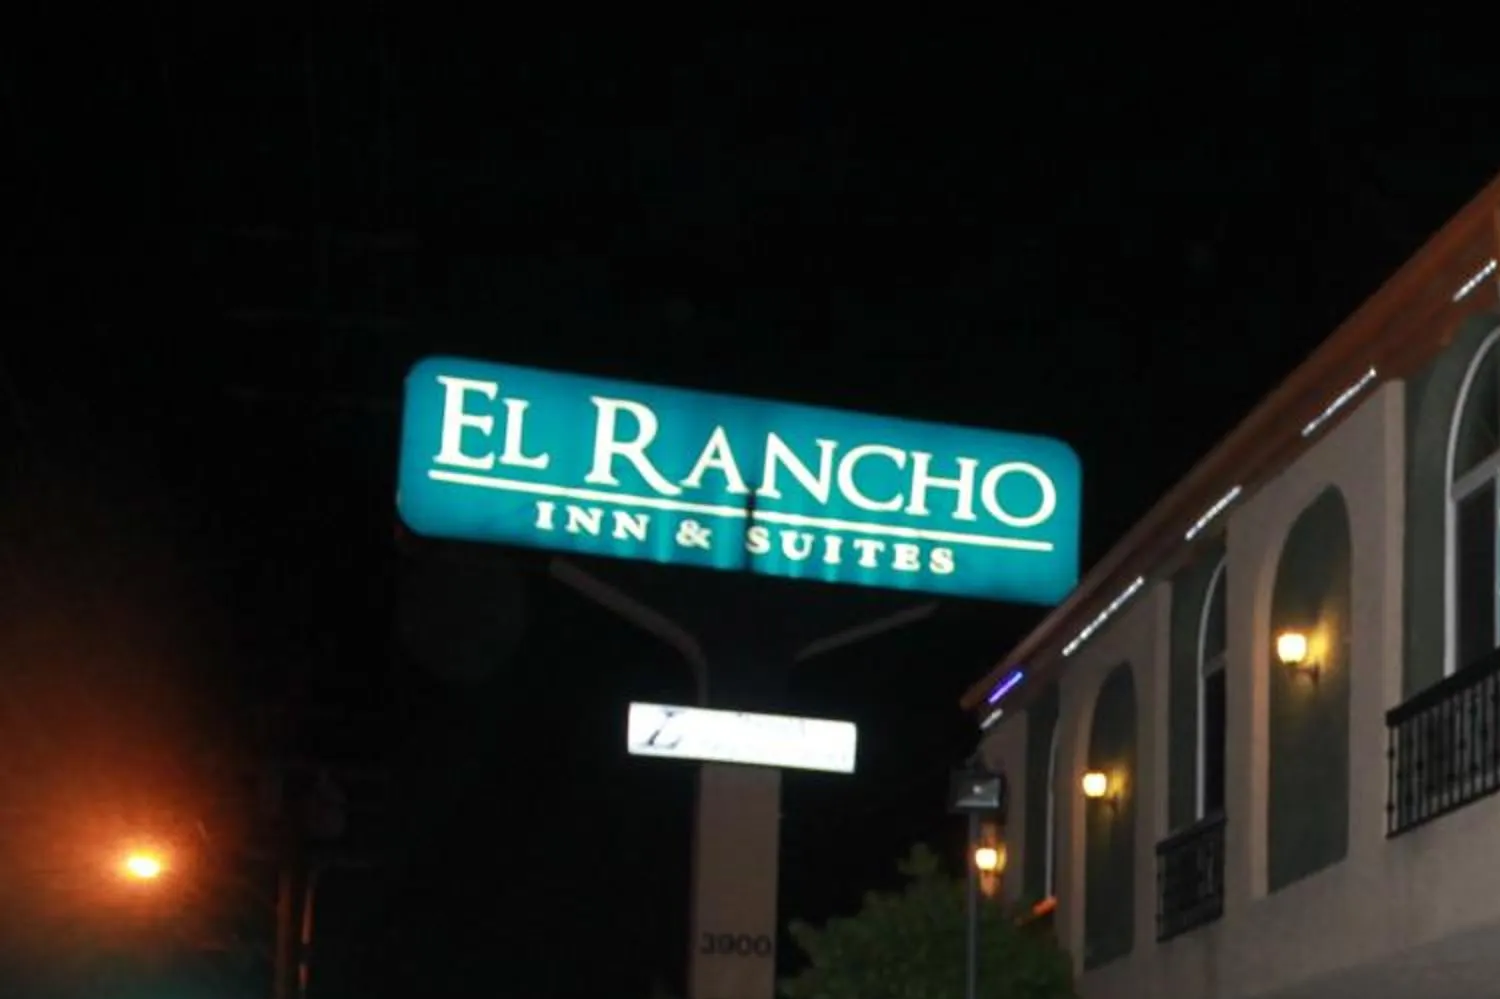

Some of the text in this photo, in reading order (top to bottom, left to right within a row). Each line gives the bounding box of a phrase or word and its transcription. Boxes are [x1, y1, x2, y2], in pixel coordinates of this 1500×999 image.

[434, 375, 1057, 528] EL RANCHO
[535, 500, 955, 575] INN & SUITES
